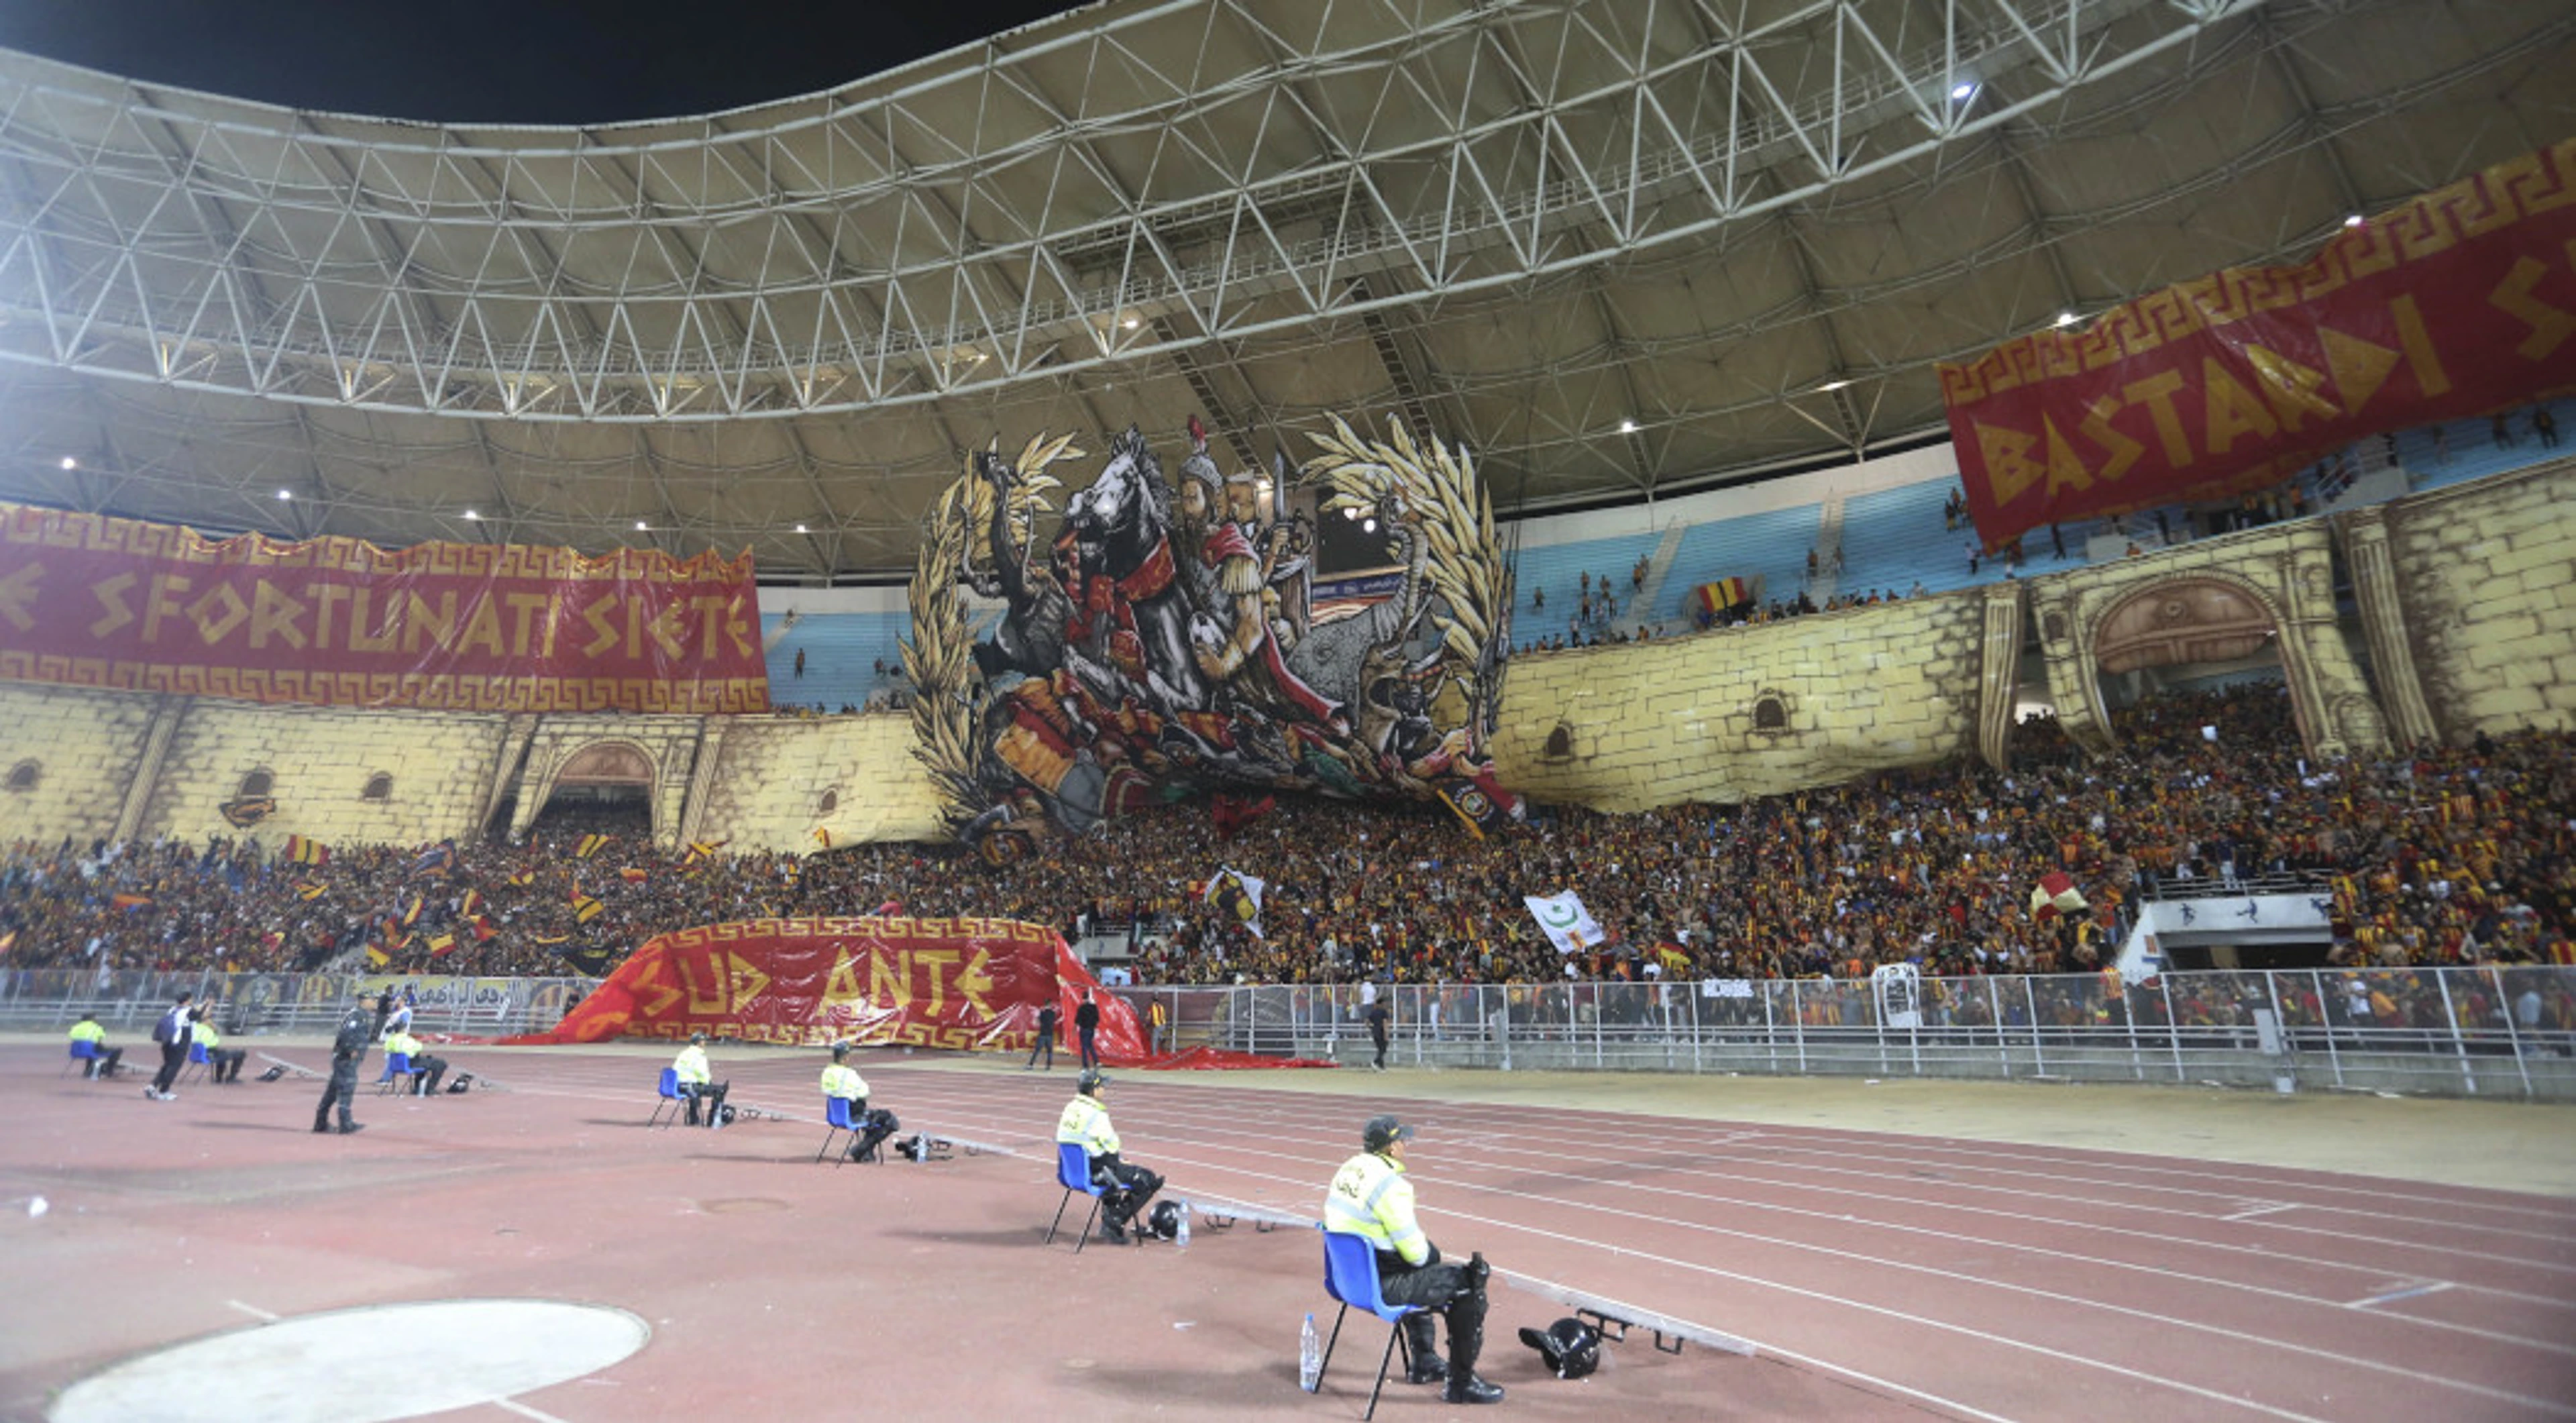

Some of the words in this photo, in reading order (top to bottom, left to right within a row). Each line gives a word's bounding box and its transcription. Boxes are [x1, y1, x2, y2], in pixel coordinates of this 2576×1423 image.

[1973, 293, 2452, 509] BASTARDI
[89, 569, 562, 660] SFORTUNATI
[581, 593, 749, 660] SIETE
[626, 947, 771, 1017] SUD
[816, 944, 998, 1023] ANTE
